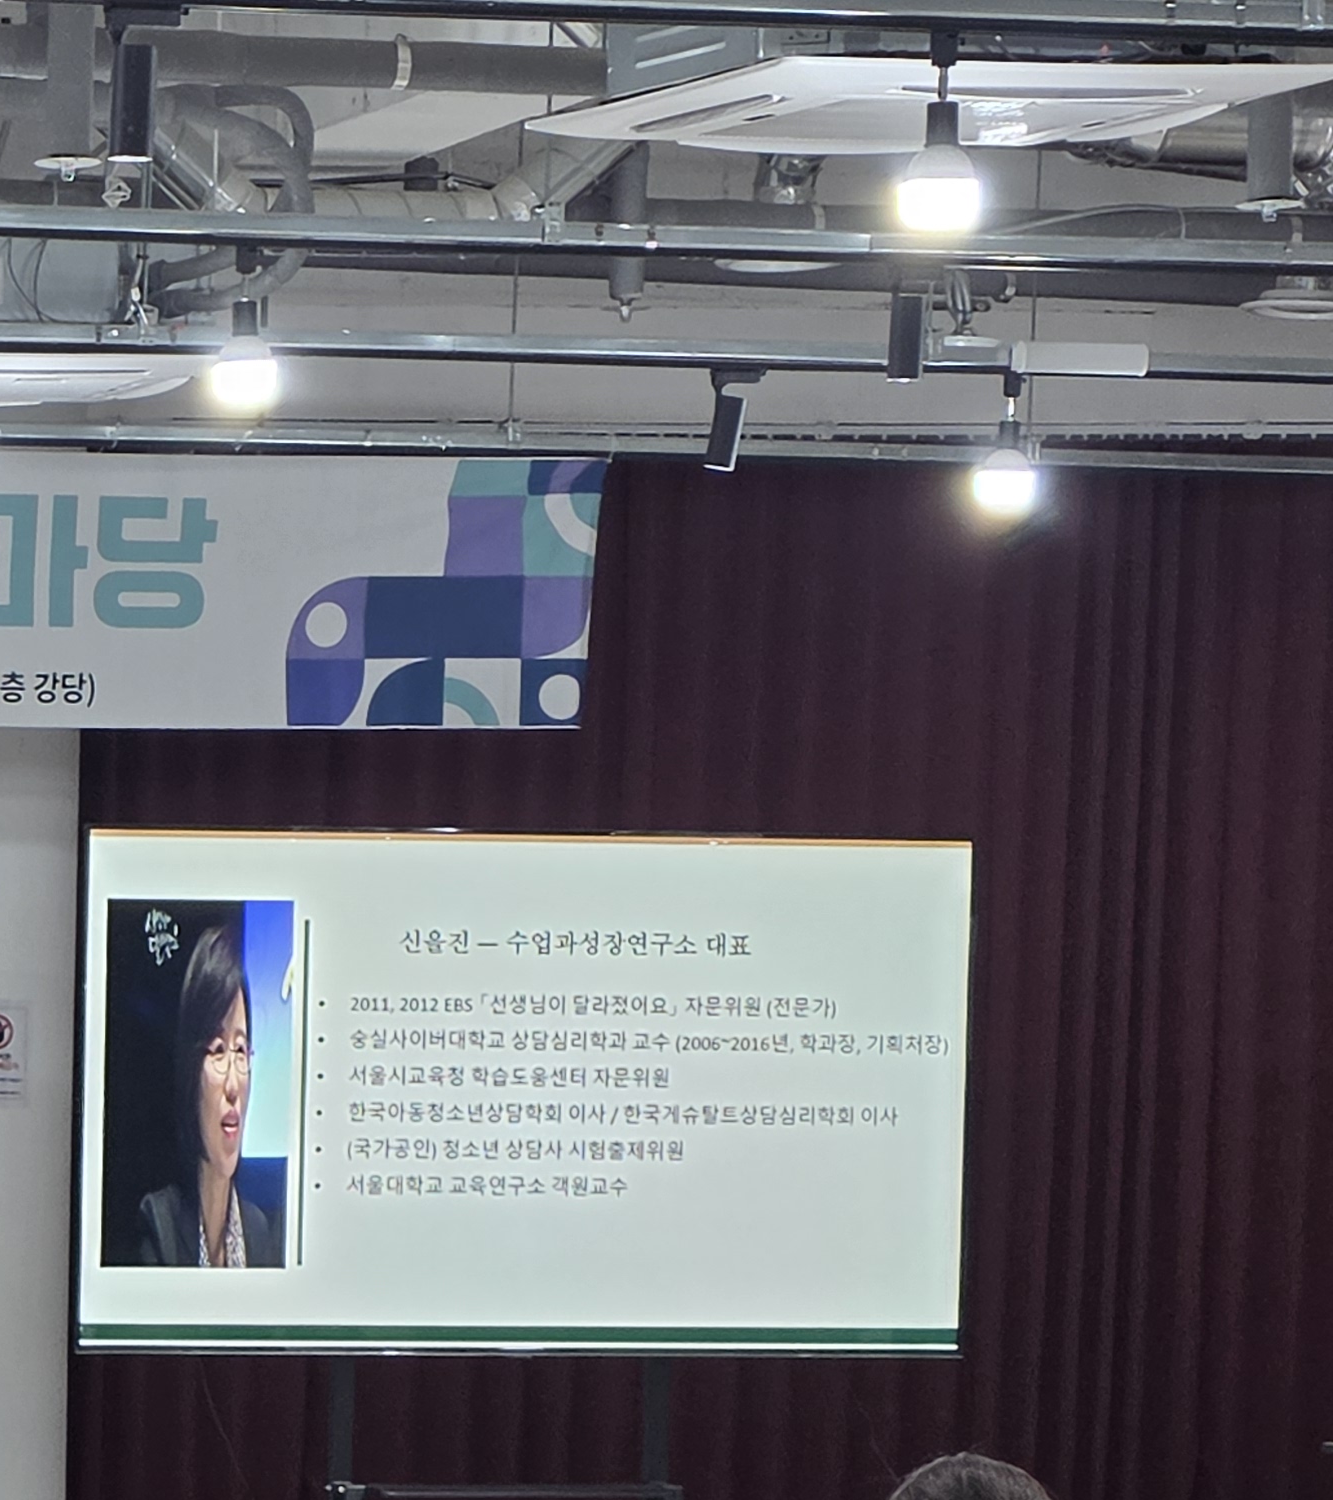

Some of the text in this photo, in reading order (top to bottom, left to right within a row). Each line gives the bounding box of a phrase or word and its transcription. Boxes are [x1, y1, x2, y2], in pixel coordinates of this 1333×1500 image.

[33, 672, 97, 709] 강당)
[399, 929, 469, 955] 신을진
[506, 930, 698, 957] 수업과성장연구소
[706, 932, 752, 957] 대표
[350, 997, 395, 1014] 2011,
[400, 997, 439, 1013] 2012
[444, 998, 474, 1013] EBS
[685, 996, 761, 1017] 자문위원
[766, 997, 837, 1019] (전문가)
[350, 1029, 949, 1056] 숭실사이버대학교 상담심리학과 교수 (2006~2016년, 학과장, 기획처장)
[349, 1065, 669, 1088] 서울시교육청 학습도움센터 자문위원
[349, 1101, 562, 1124] 한국아동청소년상담학회
[568, 1103, 606, 1125] 이사
[623, 1104, 854, 1127] 한국게슈탈트상담심리학회
[860, 1106, 898, 1127] 이사
[347, 1138, 684, 1162] (국가공인) 청소년 상담사 시험출제위원
[346, 1175, 628, 1197] 서울대학교 교육연구소 객원교수
